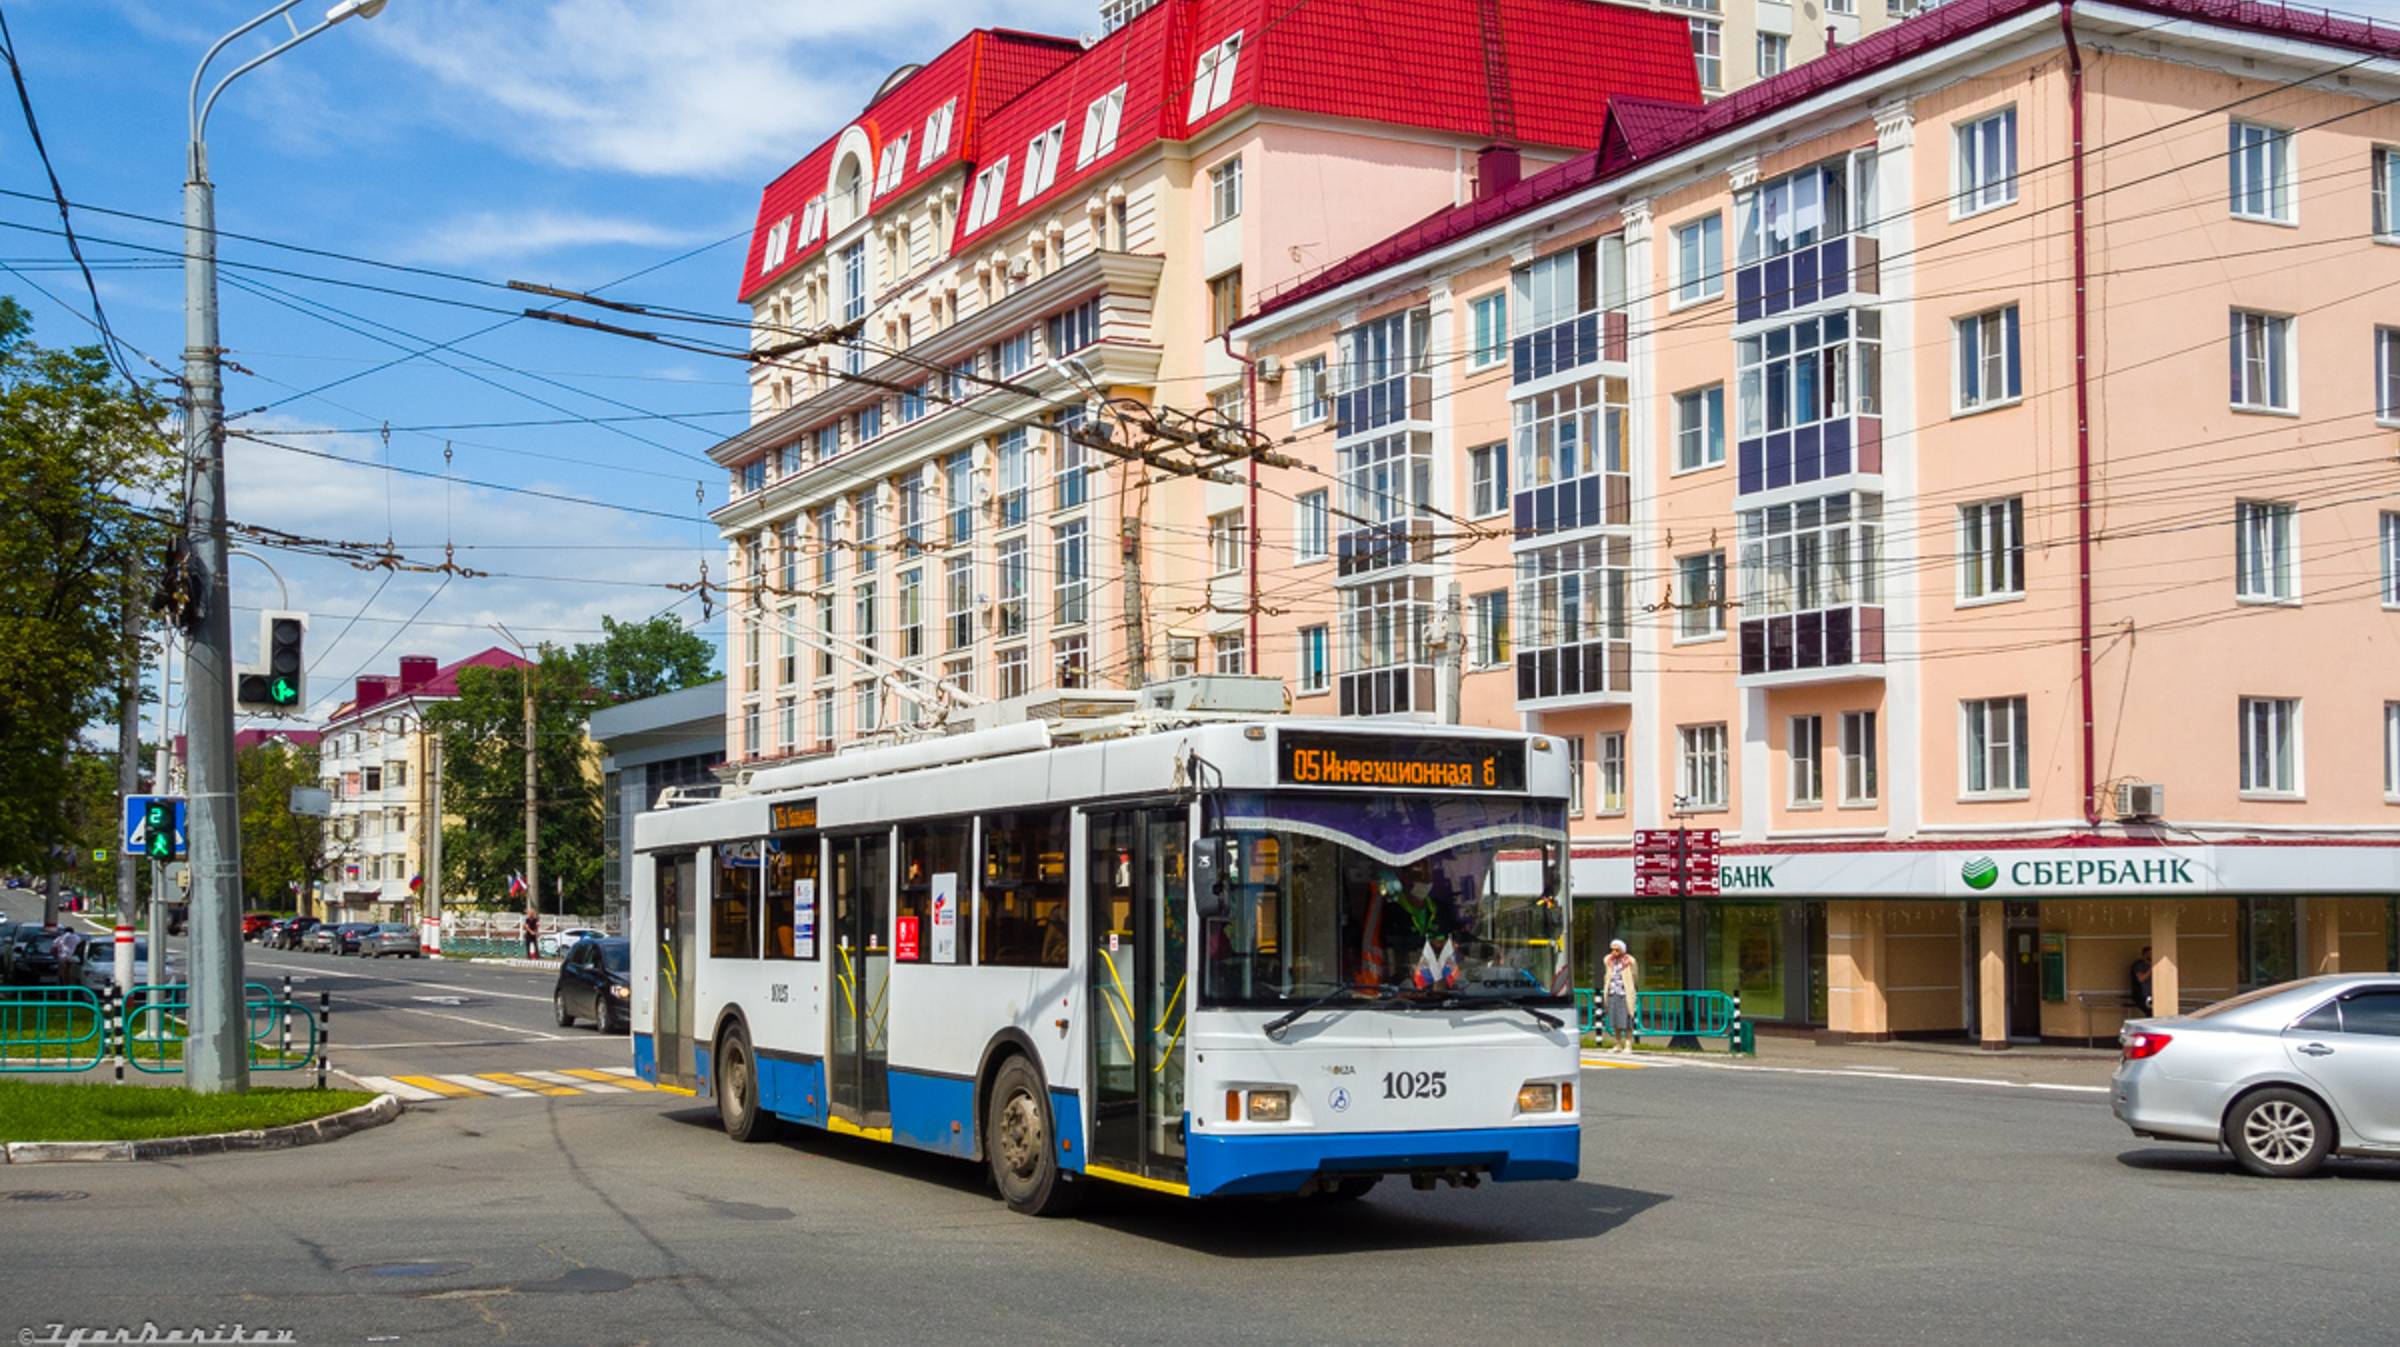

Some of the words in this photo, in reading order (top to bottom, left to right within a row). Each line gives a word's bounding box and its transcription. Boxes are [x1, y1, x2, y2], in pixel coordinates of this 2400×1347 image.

[1294, 749, 1320, 782] 05
[149, 807, 162, 824] 2
[1721, 865, 1775, 888] БАНК
[2011, 858, 2194, 887] СБЕРБАНК
[1383, 1071, 1448, 1100] 1025
